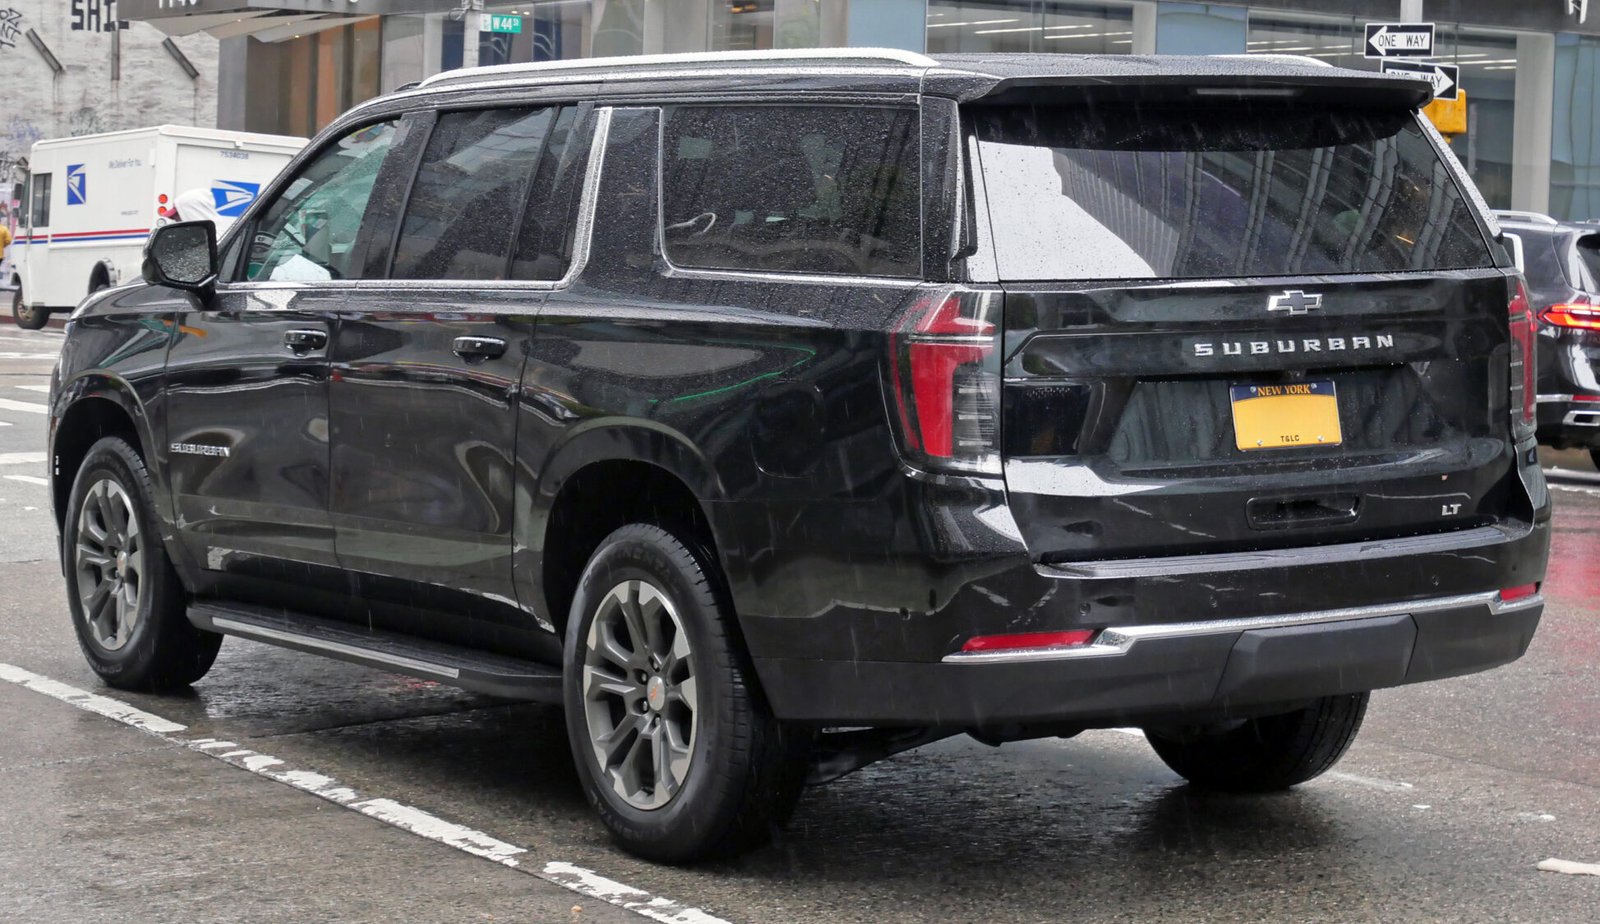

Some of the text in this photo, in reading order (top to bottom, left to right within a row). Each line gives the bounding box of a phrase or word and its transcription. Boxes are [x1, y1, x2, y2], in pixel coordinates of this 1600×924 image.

[492, 16, 501, 30] W
[501, 17, 512, 30] 44
[1378, 34, 1426, 47] ONE WAY
[1194, 334, 1394, 357] SUBURBAN
[1257, 384, 1311, 397] NEW YORK
[170, 443, 230, 457] SUBURBAN
[1441, 503, 1462, 516] LT
